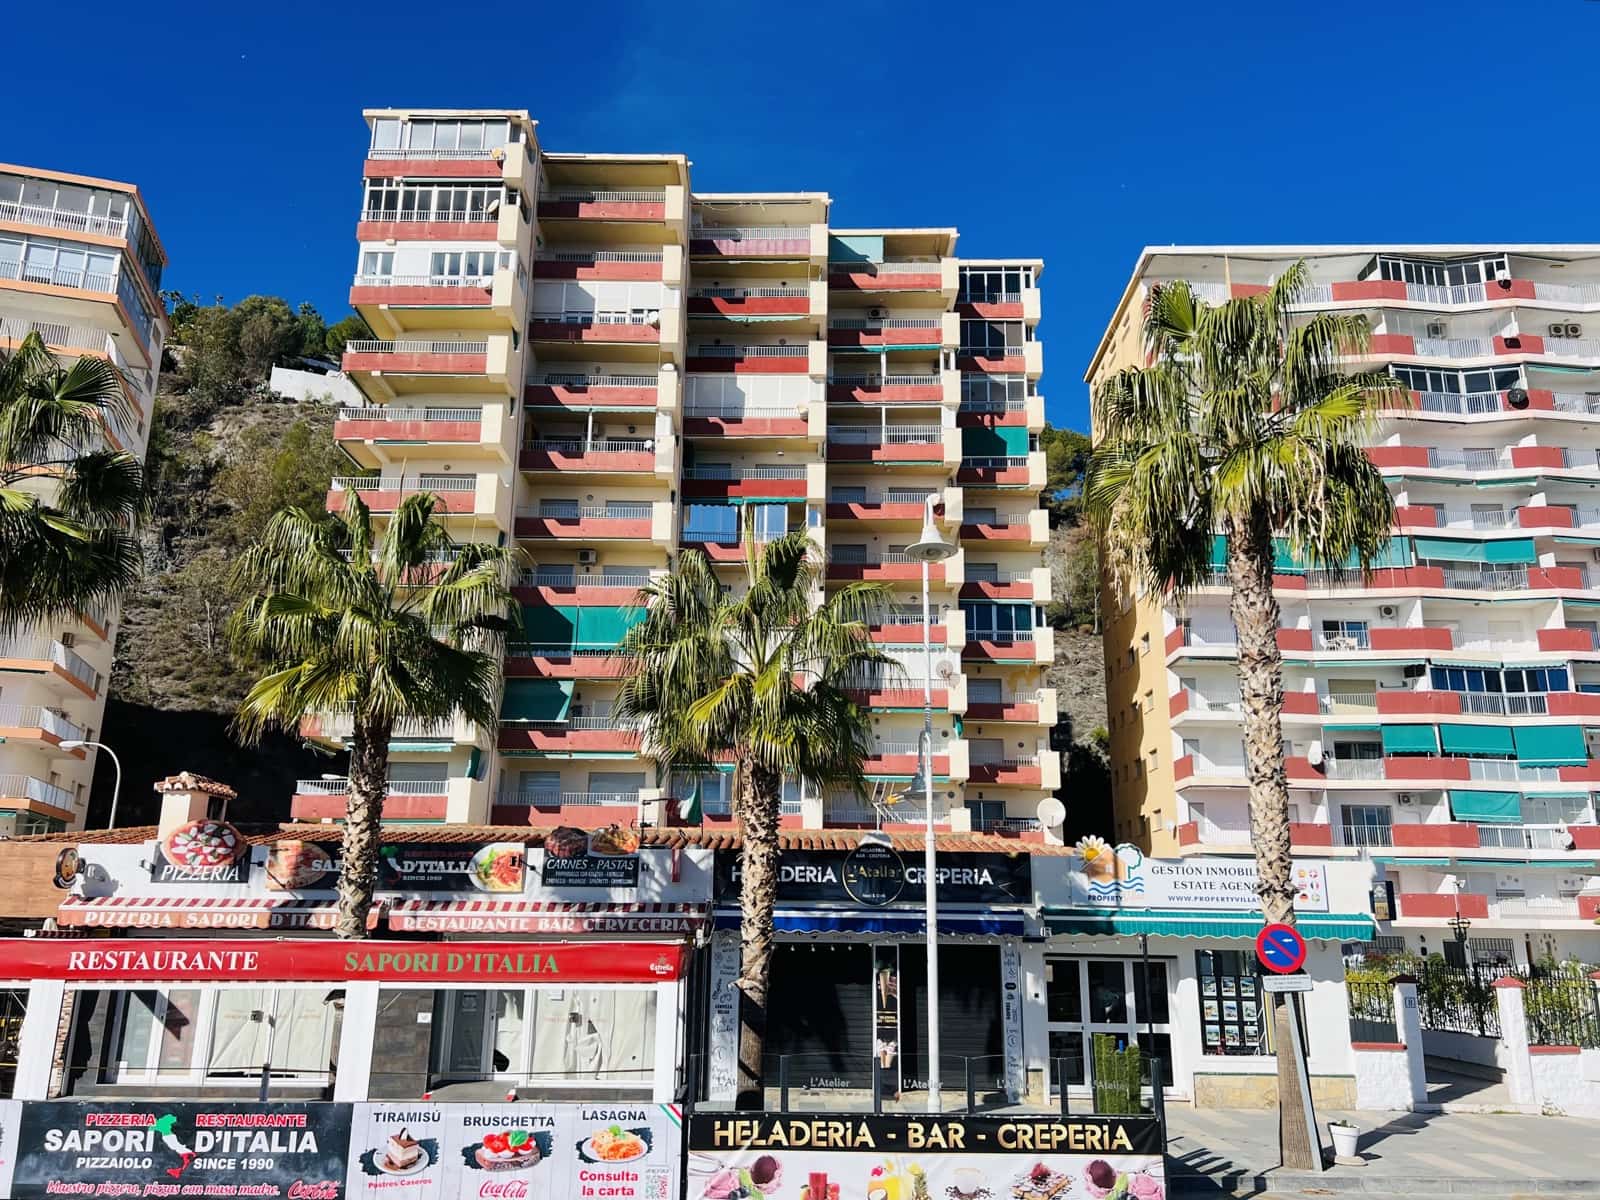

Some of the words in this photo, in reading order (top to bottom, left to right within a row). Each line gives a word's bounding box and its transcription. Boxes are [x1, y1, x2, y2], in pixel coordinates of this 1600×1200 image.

[546, 859, 589, 870] CARNES
[596, 859, 635, 870] PASTAS
[1151, 864, 1202, 875] GESTIÓN
[160, 864, 239, 881] PIZZERIA
[1174, 881, 1216, 890] ESTATE
[1220, 882, 1258, 891] AGENC
[1087, 894, 1123, 902] PROPERTY
[84, 912, 172, 926] PIZZERIA
[186, 912, 258, 927] SAPORI
[271, 913, 340, 928] D'ITALI
[403, 917, 528, 931] RESTAURANTE
[538, 917, 575, 931] BAR
[583, 917, 690, 932] CERVECERIA
[68, 951, 259, 971] RESTAURANTE
[344, 952, 440, 973] SAPORI
[446, 952, 560, 973] D'ITALIA
[809, 1076, 850, 1088] L'Atelier
[85, 1113, 156, 1127] PIZZERIA
[195, 1113, 307, 1127] RESTAURANTE
[463, 1116, 556, 1127] BRUSCHETTA
[582, 1110, 647, 1121] LASAGNA
[44, 1129, 154, 1152] SAPORI
[194, 1130, 318, 1153] D'ITALIA
[907, 1122, 966, 1149] BAR
[76, 1157, 152, 1169] PIZZAIOLO
[193, 1158, 236, 1170] SINCE
[240, 1158, 274, 1170] 1990
[579, 1170, 639, 1182] Consulta
[142, 1180, 181, 1197] pizzas
[582, 1185, 594, 1196] la
[598, 1186, 635, 1197] carta
